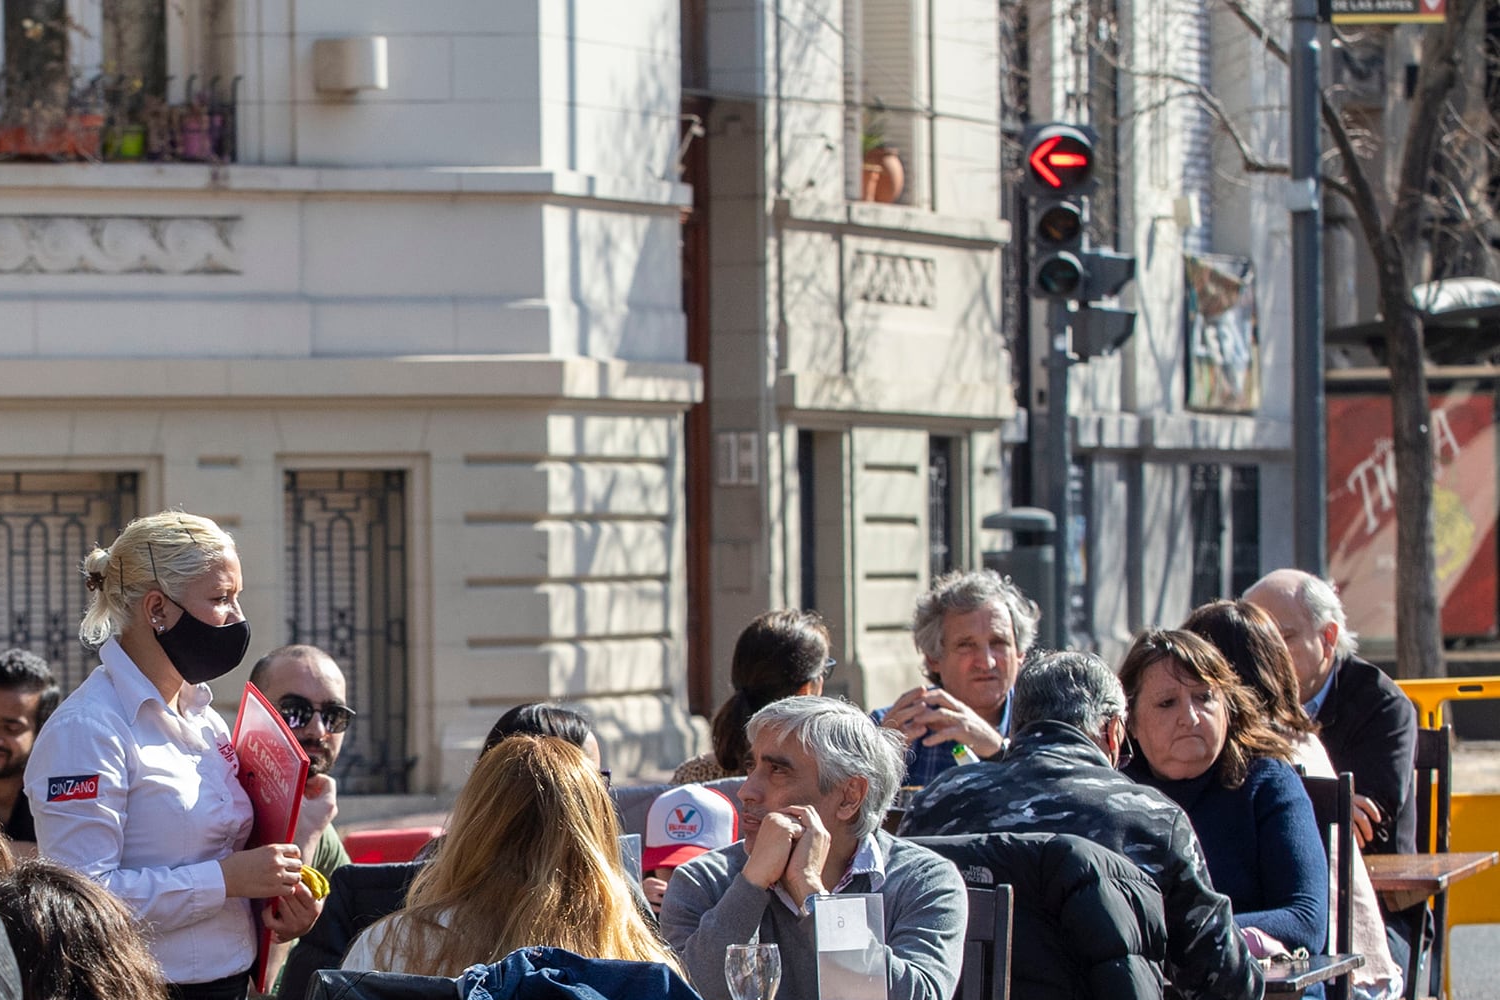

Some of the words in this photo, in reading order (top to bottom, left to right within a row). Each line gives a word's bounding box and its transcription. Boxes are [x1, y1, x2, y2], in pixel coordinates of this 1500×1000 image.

[1350, 0, 1373, 12] LAS
[1375, 0, 1414, 11] ARTES
[247, 734, 259, 757] LA
[259, 747, 290, 799] POPULAR
[50, 780, 96, 796] CINZANO
